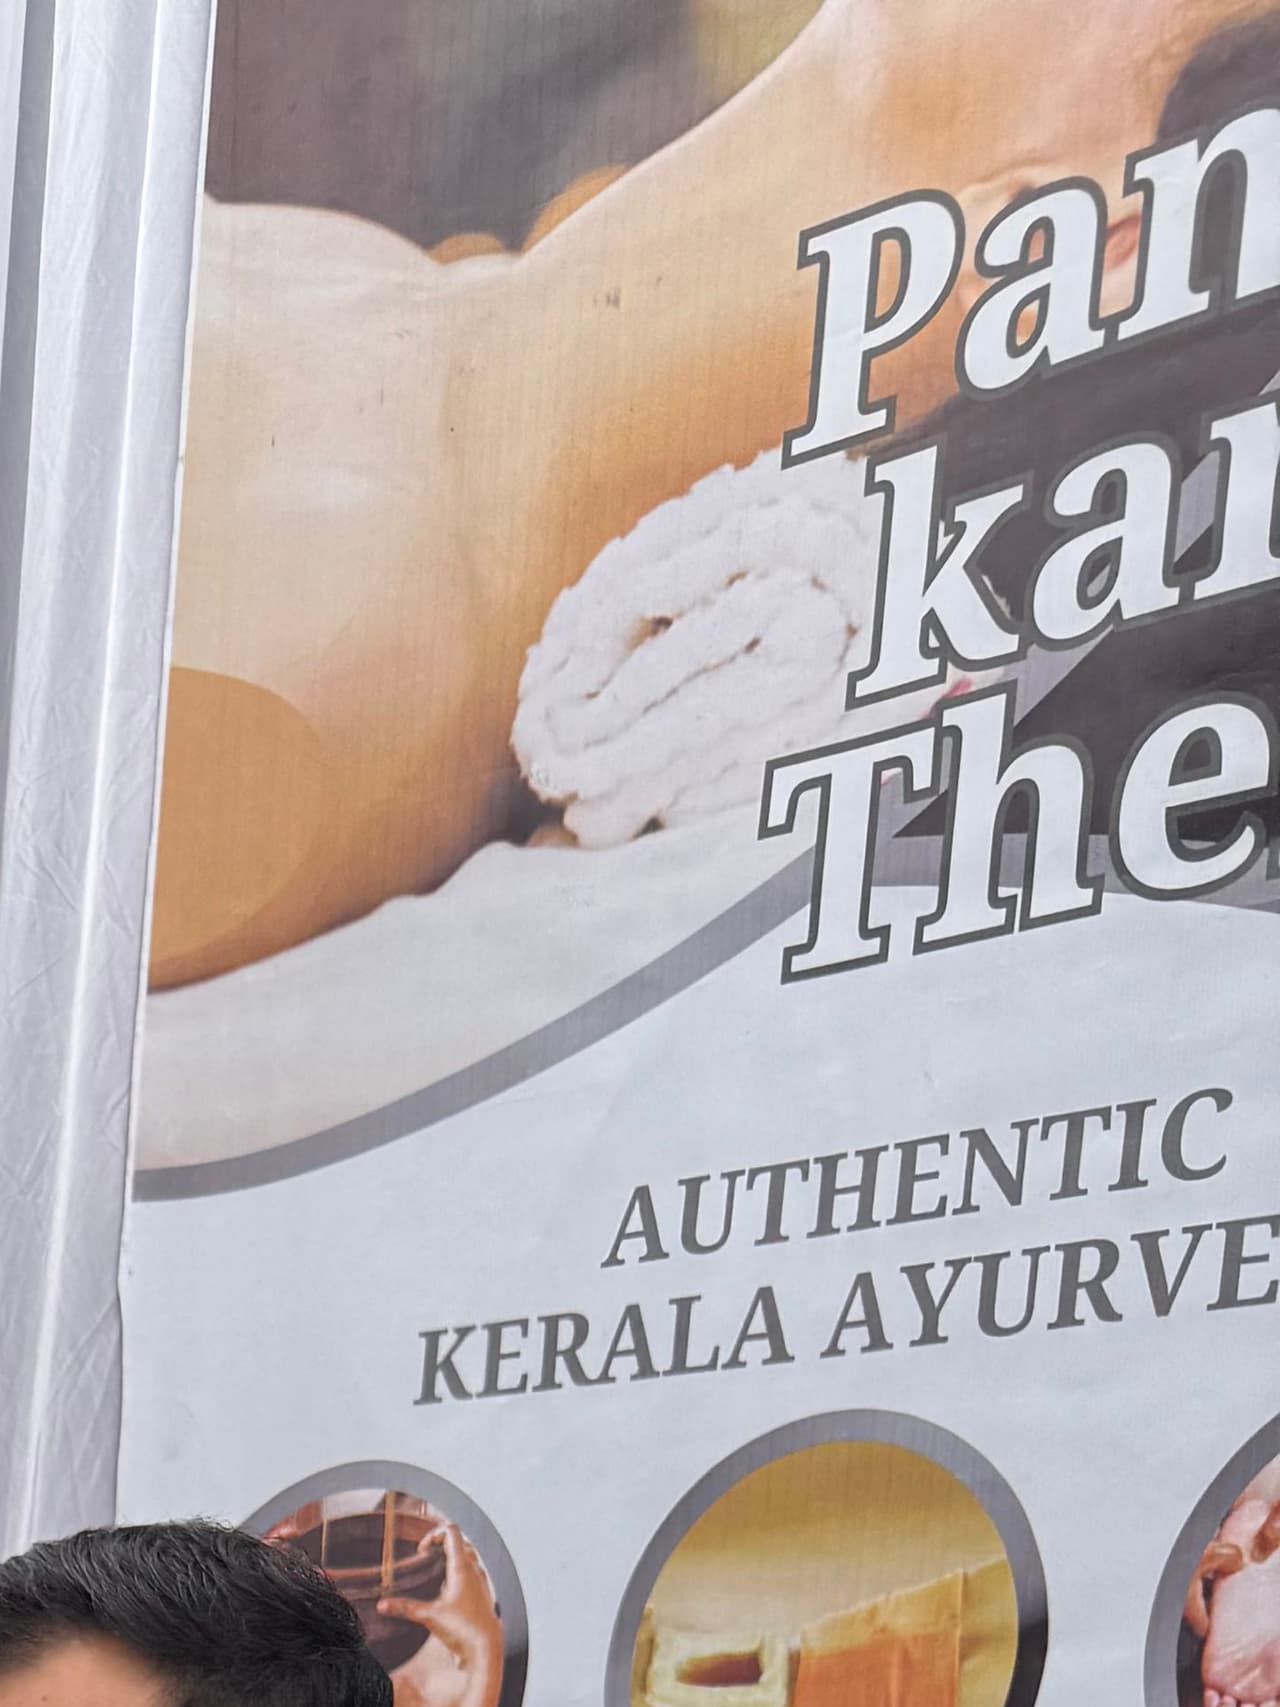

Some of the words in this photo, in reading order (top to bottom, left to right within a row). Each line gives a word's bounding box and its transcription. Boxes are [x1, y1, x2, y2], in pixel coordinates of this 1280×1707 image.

[757, 678, 1280, 984] The
[600, 1088, 1234, 1269] AUTHENTIC
[412, 1286, 796, 1406] KERALA
[819, 1214, 1280, 1360] AYURVE
